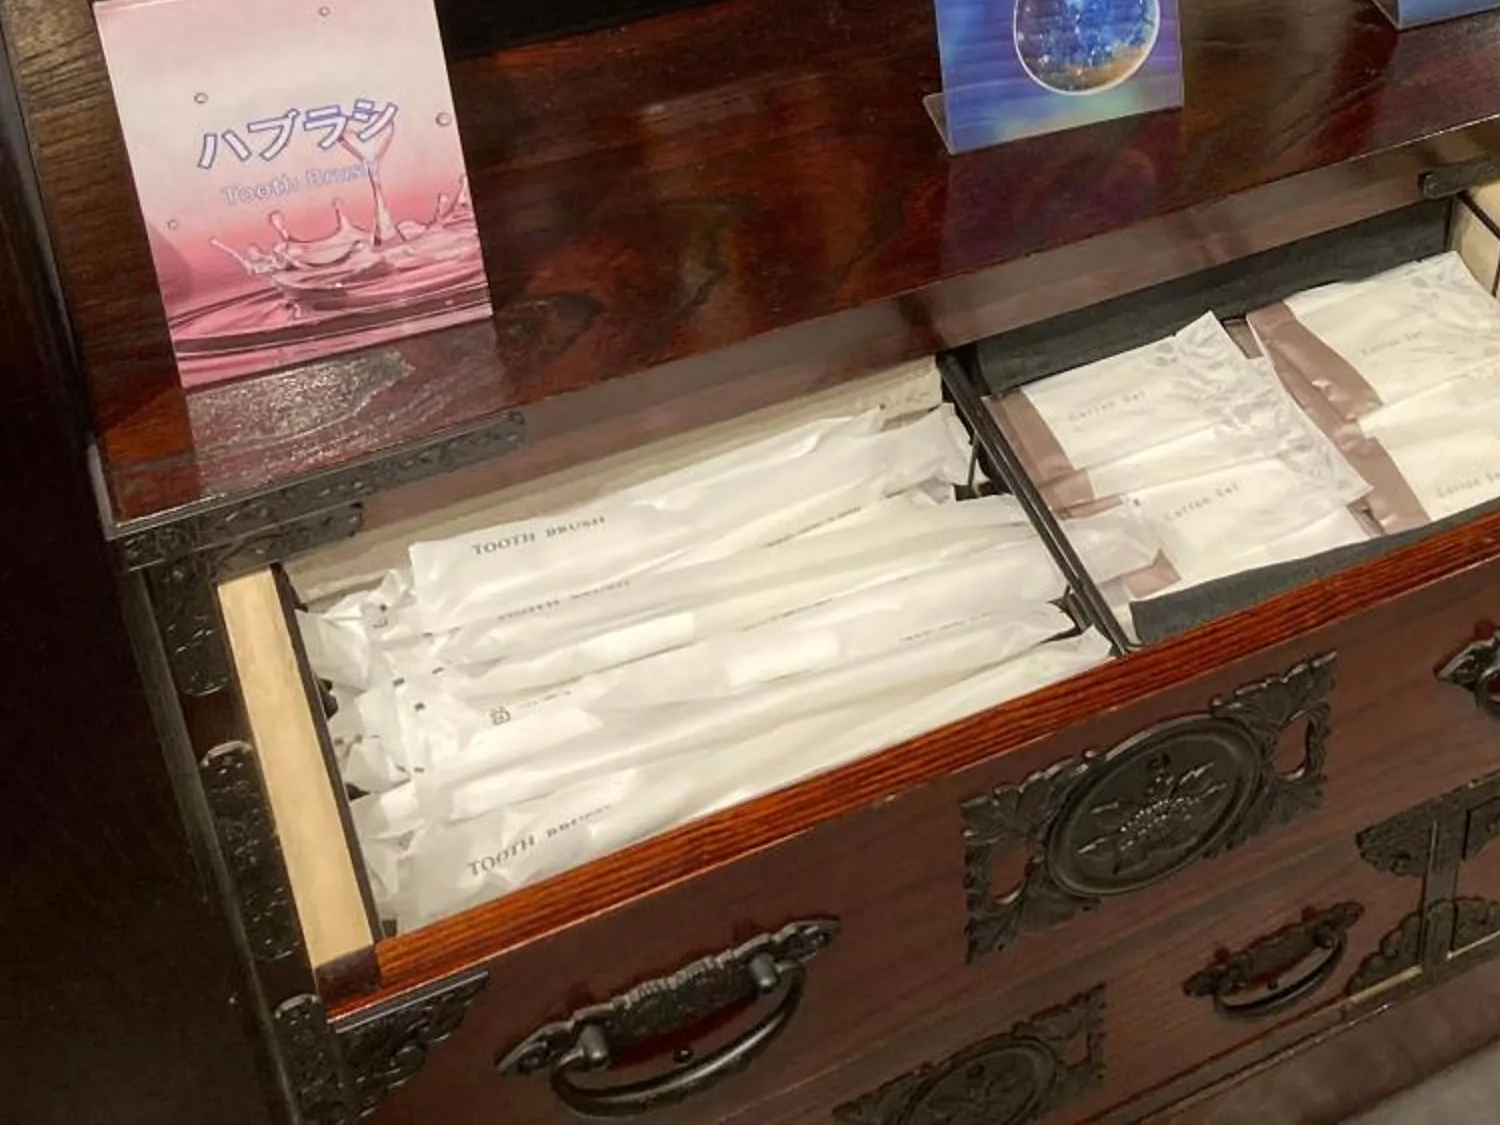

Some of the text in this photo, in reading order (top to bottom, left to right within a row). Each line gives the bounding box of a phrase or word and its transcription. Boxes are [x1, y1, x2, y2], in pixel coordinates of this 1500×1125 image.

[197, 98, 400, 171] ハブラシ
[221, 174, 300, 208] Tooth
[471, 533, 535, 556] TOOTH
[469, 835, 535, 876] TOOTH
